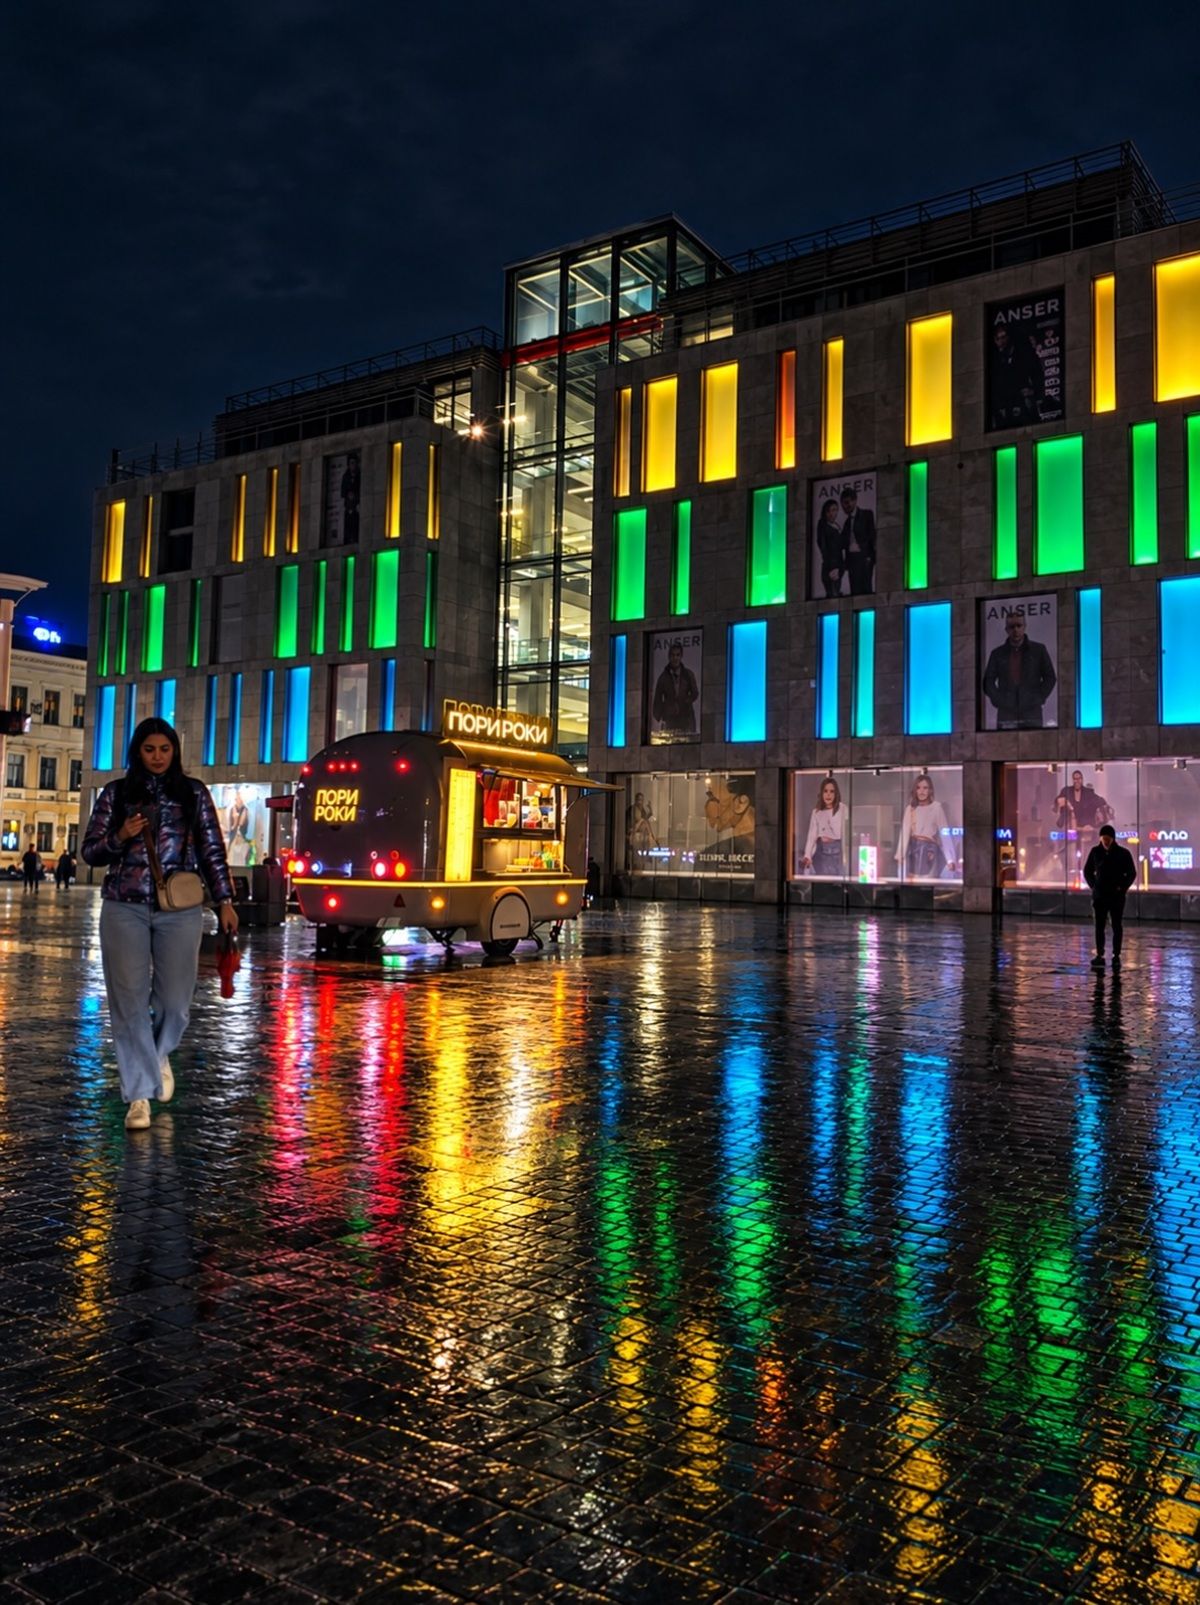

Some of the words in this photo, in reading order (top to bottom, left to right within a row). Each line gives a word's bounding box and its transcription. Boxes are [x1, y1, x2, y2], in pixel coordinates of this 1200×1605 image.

[994, 299, 1060, 325] ANSER
[987, 602, 1051, 620] ANSER
[653, 635, 701, 650] ANSER
[316, 789, 359, 805] ПОРИ
[314, 805, 357, 822] РОКИ
